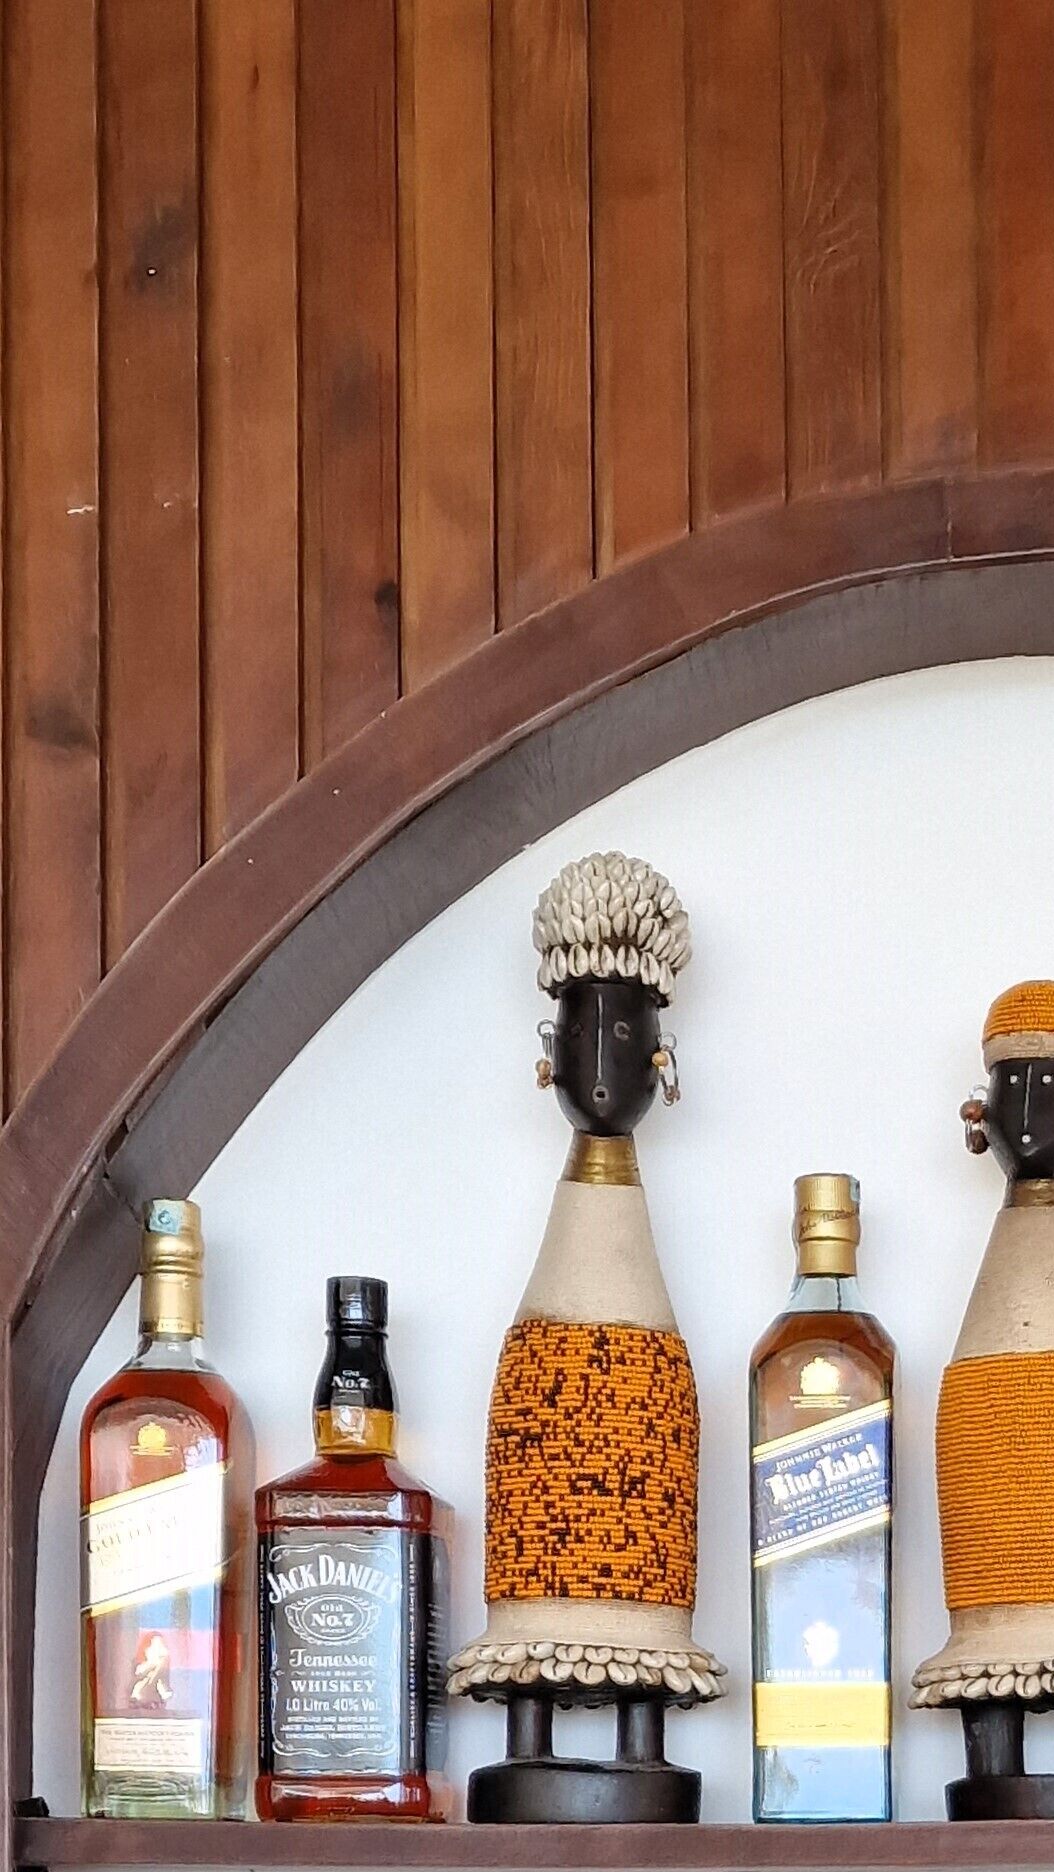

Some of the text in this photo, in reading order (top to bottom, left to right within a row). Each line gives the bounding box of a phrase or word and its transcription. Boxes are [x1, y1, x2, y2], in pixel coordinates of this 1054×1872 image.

[331, 1376, 370, 1389] No.7
[764, 1443, 880, 1505] Blue Label
[267, 1562, 316, 1604] JACK
[320, 1603, 343, 1612] Old
[310, 1612, 354, 1627] No.7
[289, 1648, 376, 1667] Tennessee
[290, 1680, 377, 1692] WHISKEY
[333, 1698, 359, 1712] 40%
